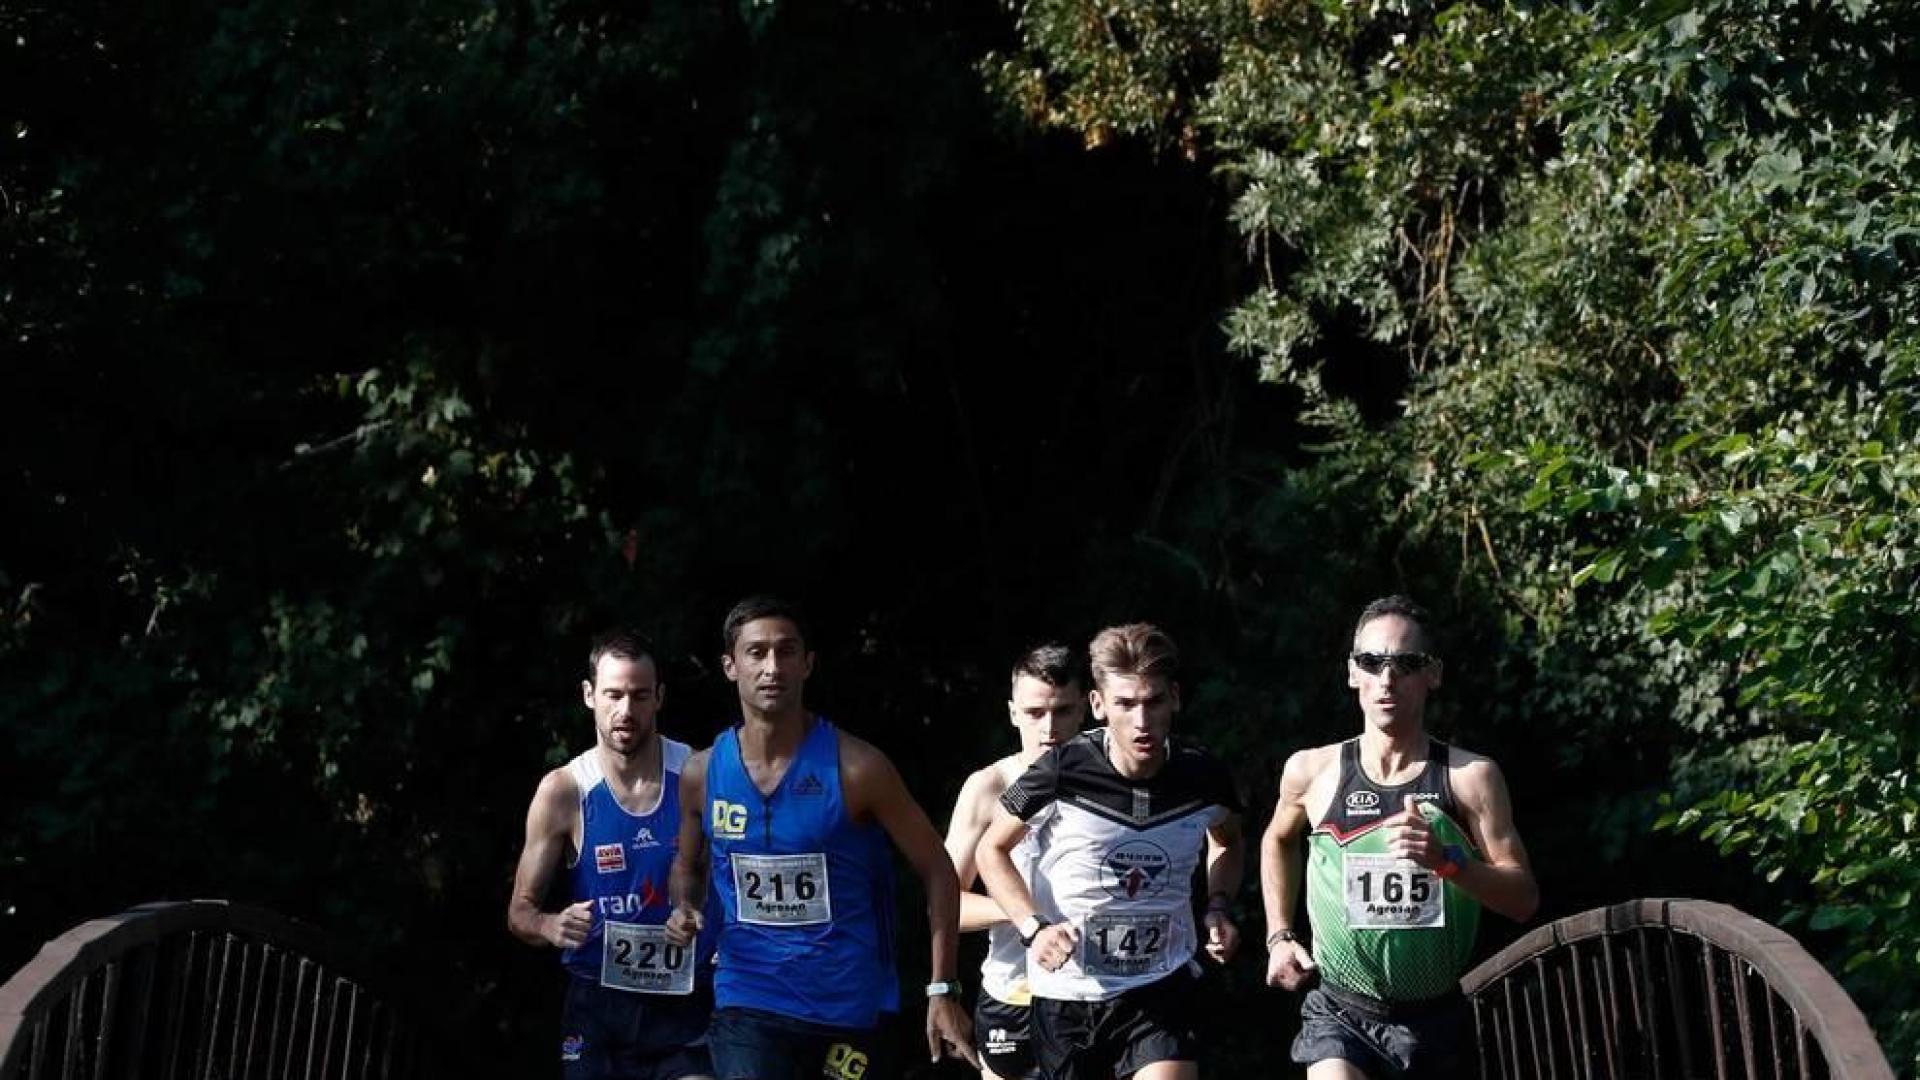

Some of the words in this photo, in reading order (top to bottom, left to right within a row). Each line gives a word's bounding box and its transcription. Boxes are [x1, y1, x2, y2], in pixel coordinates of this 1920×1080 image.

[714, 800, 748, 833] DG
[745, 871, 816, 902] 216
[1357, 872, 1430, 903] 165
[614, 939, 684, 970] 220
[1096, 926, 1160, 955] 142
[826, 1042, 868, 1079] DG
